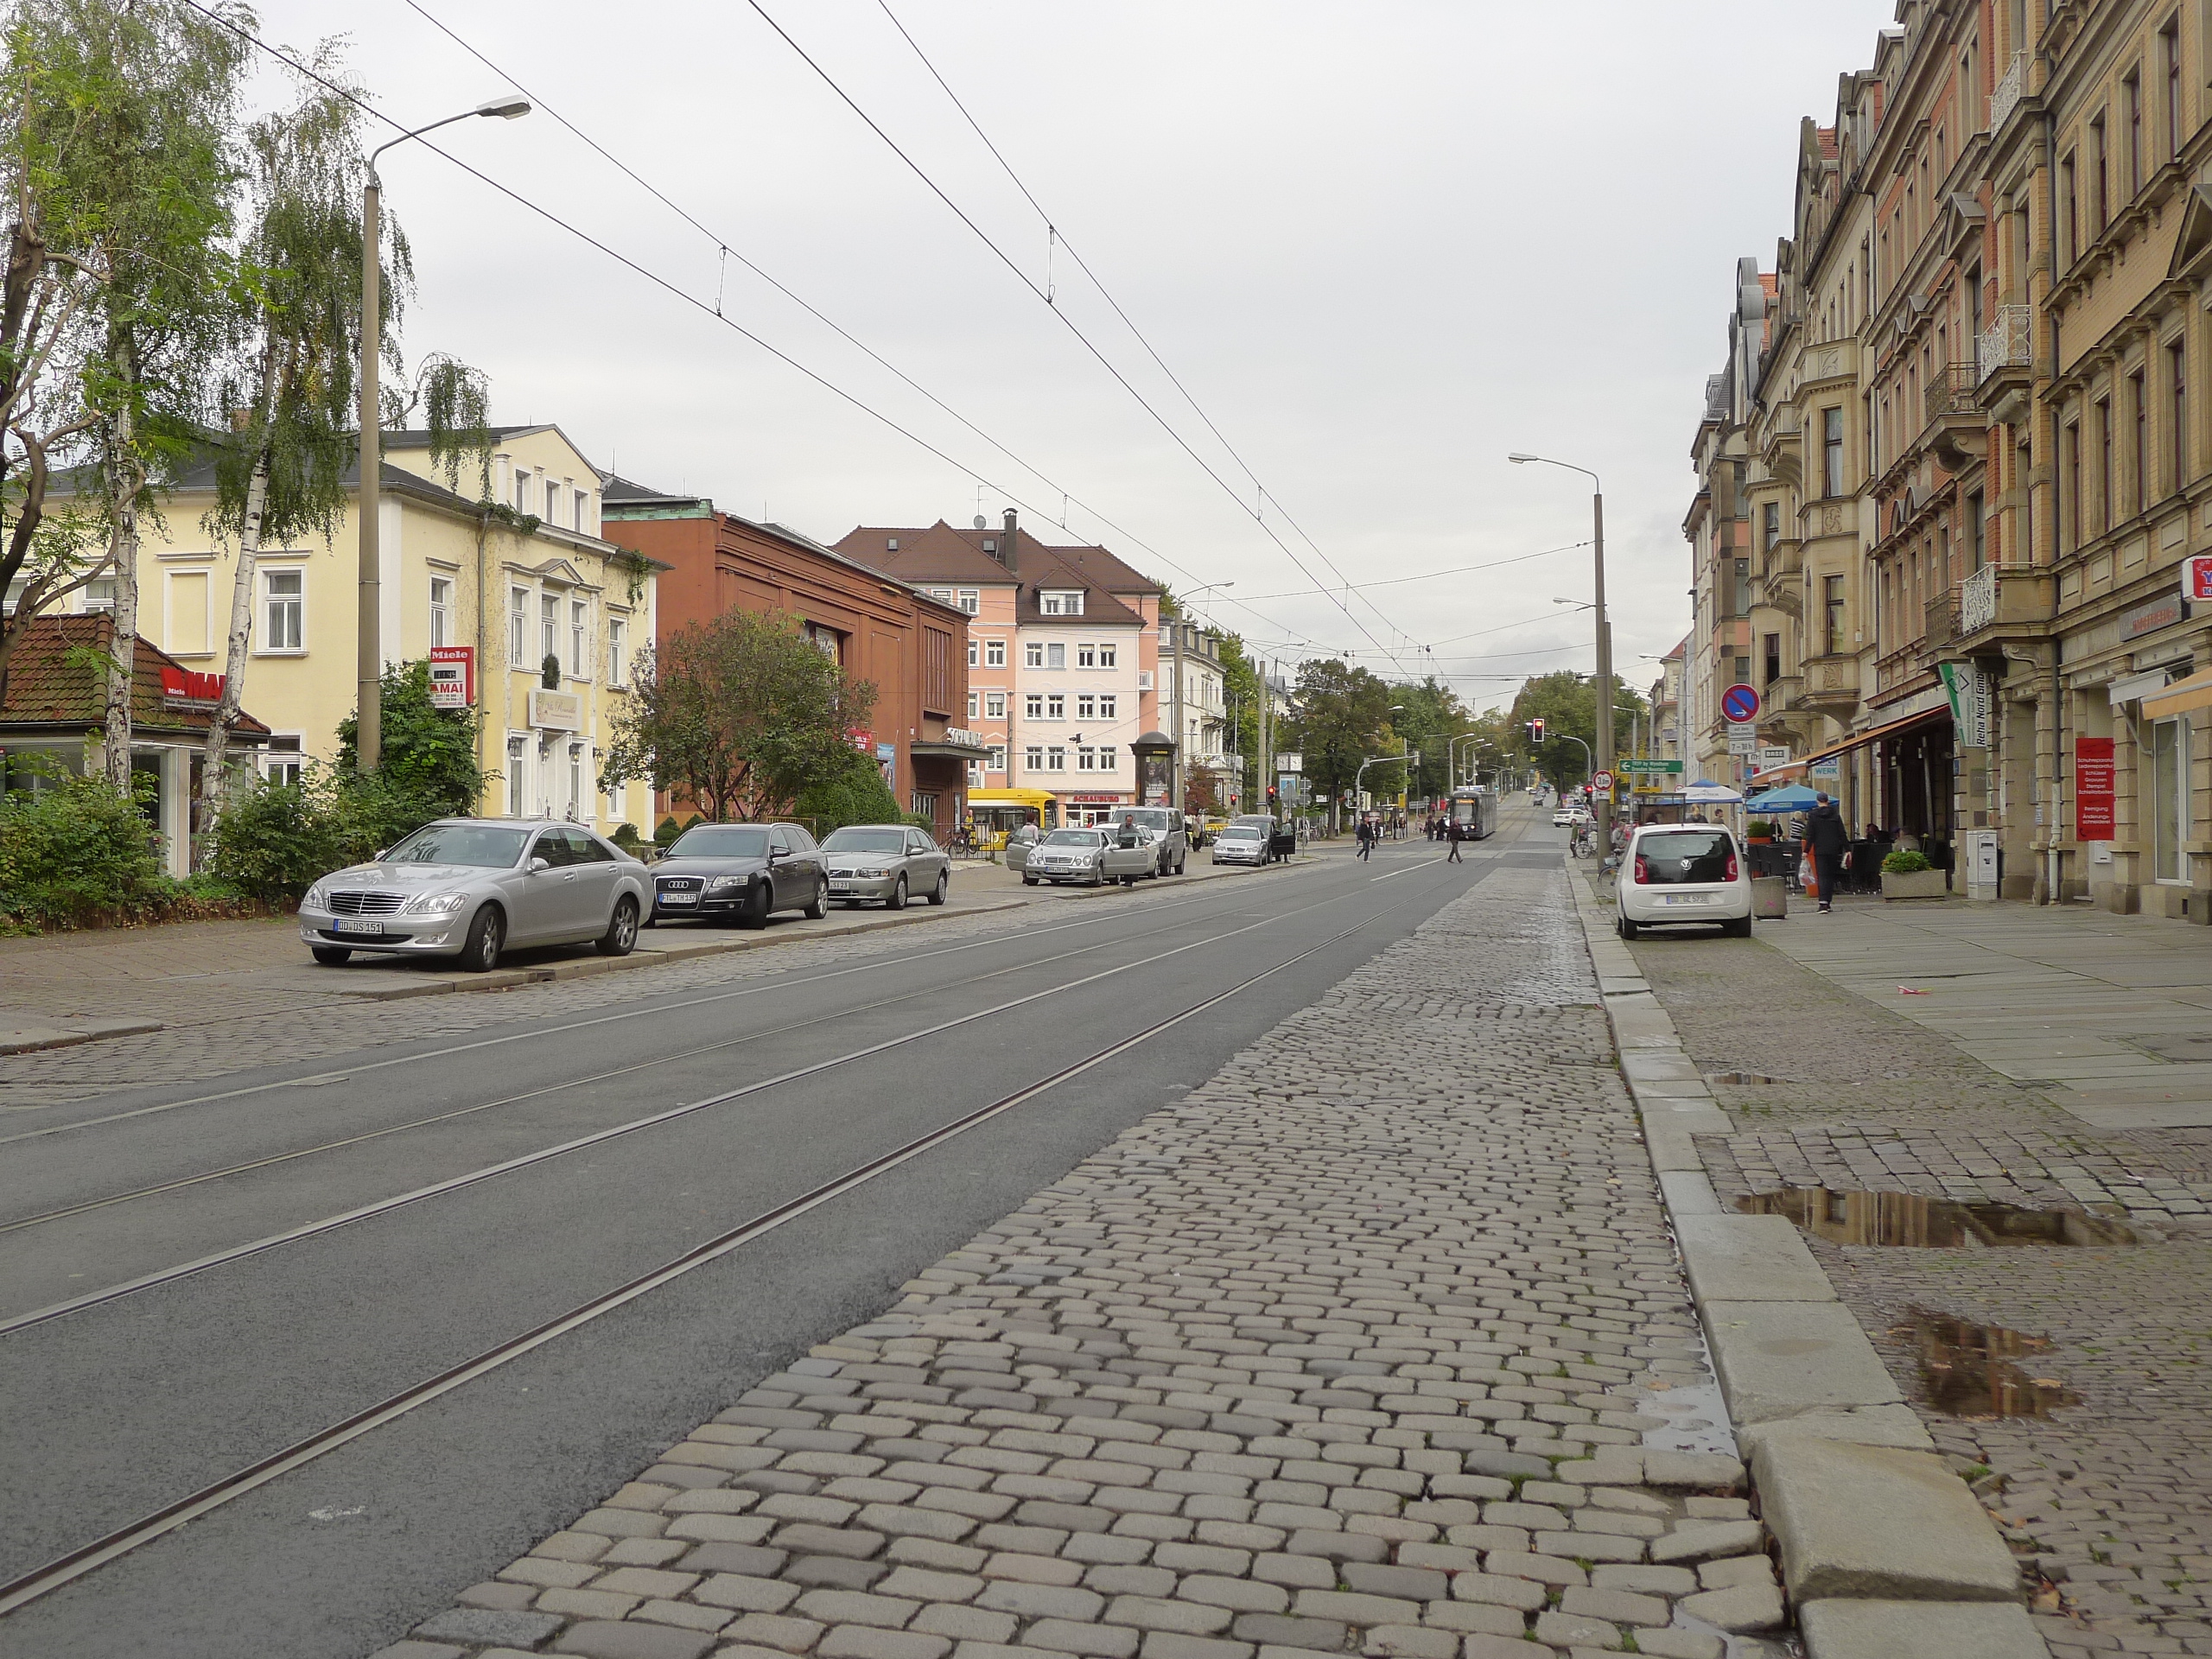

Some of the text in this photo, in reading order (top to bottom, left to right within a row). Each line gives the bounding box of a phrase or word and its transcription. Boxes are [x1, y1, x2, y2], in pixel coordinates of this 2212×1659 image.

[431, 651, 468, 659] Miele
[440, 683, 463, 693] MAI
[1975, 696, 1986, 719] Nord
[1976, 721, 1986, 746] Reha
[339, 921, 381, 933] DD DS 151
